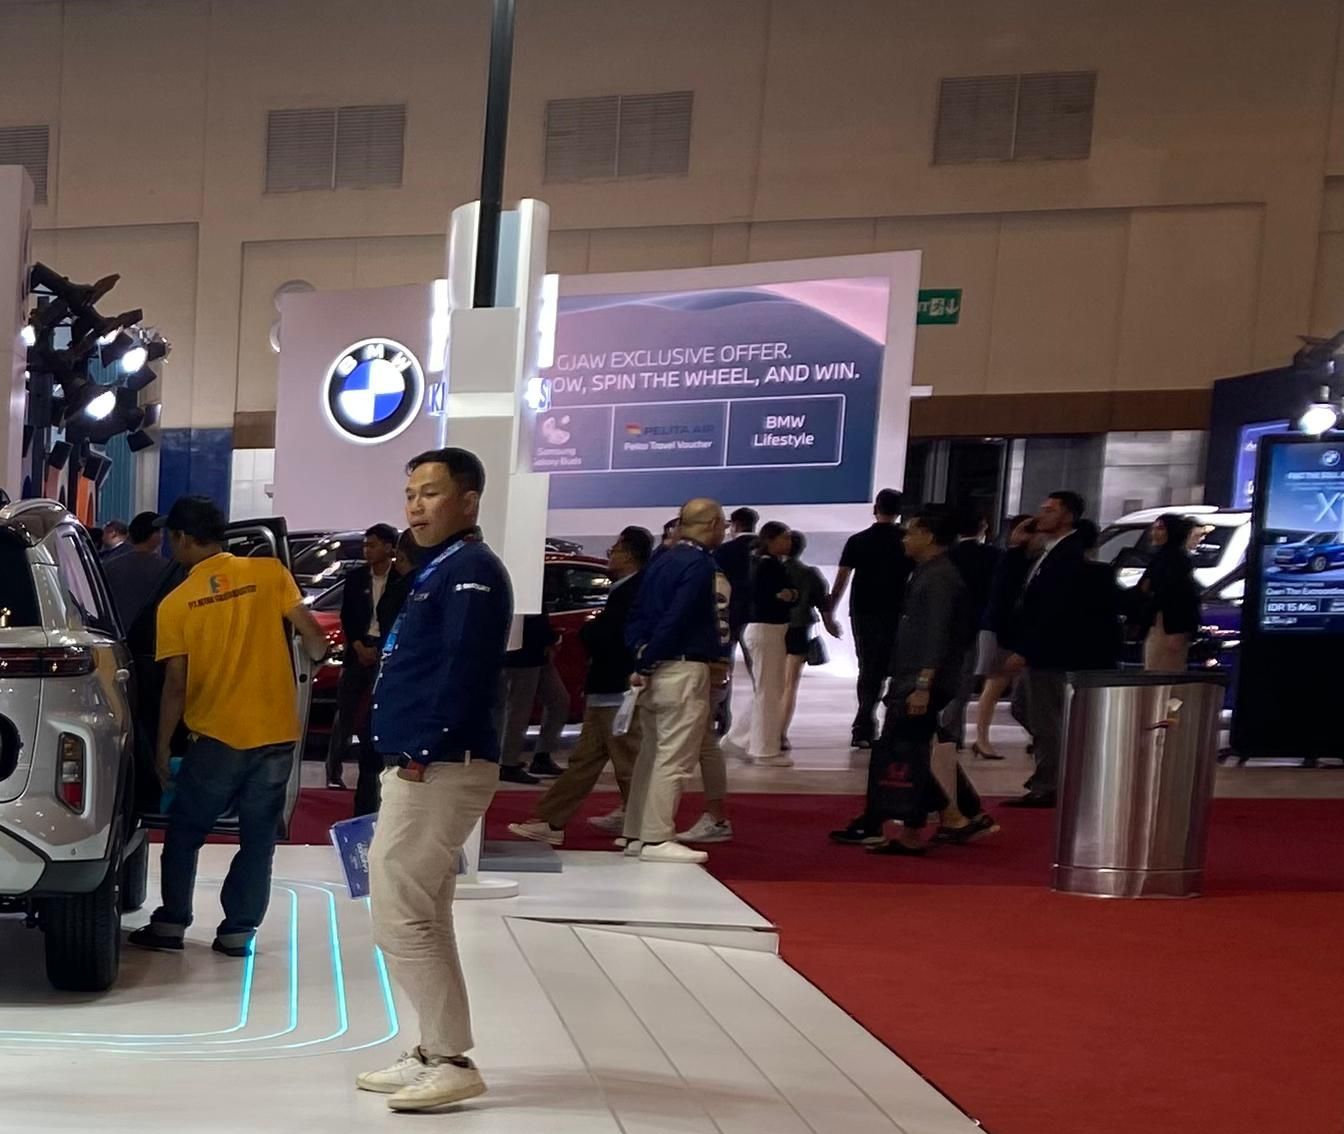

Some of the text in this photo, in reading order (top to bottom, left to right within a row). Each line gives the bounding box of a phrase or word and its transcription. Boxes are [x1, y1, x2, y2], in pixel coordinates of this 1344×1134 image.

[337, 343, 413, 377] BMW
[557, 342, 793, 372] GJAW EXCLUSIVE OFFER.
[552, 361, 861, 395] OW, SPIN THE WHEEL, AND WIN.
[765, 414, 806, 430] BMW
[753, 432, 815, 448] Lifestyle
